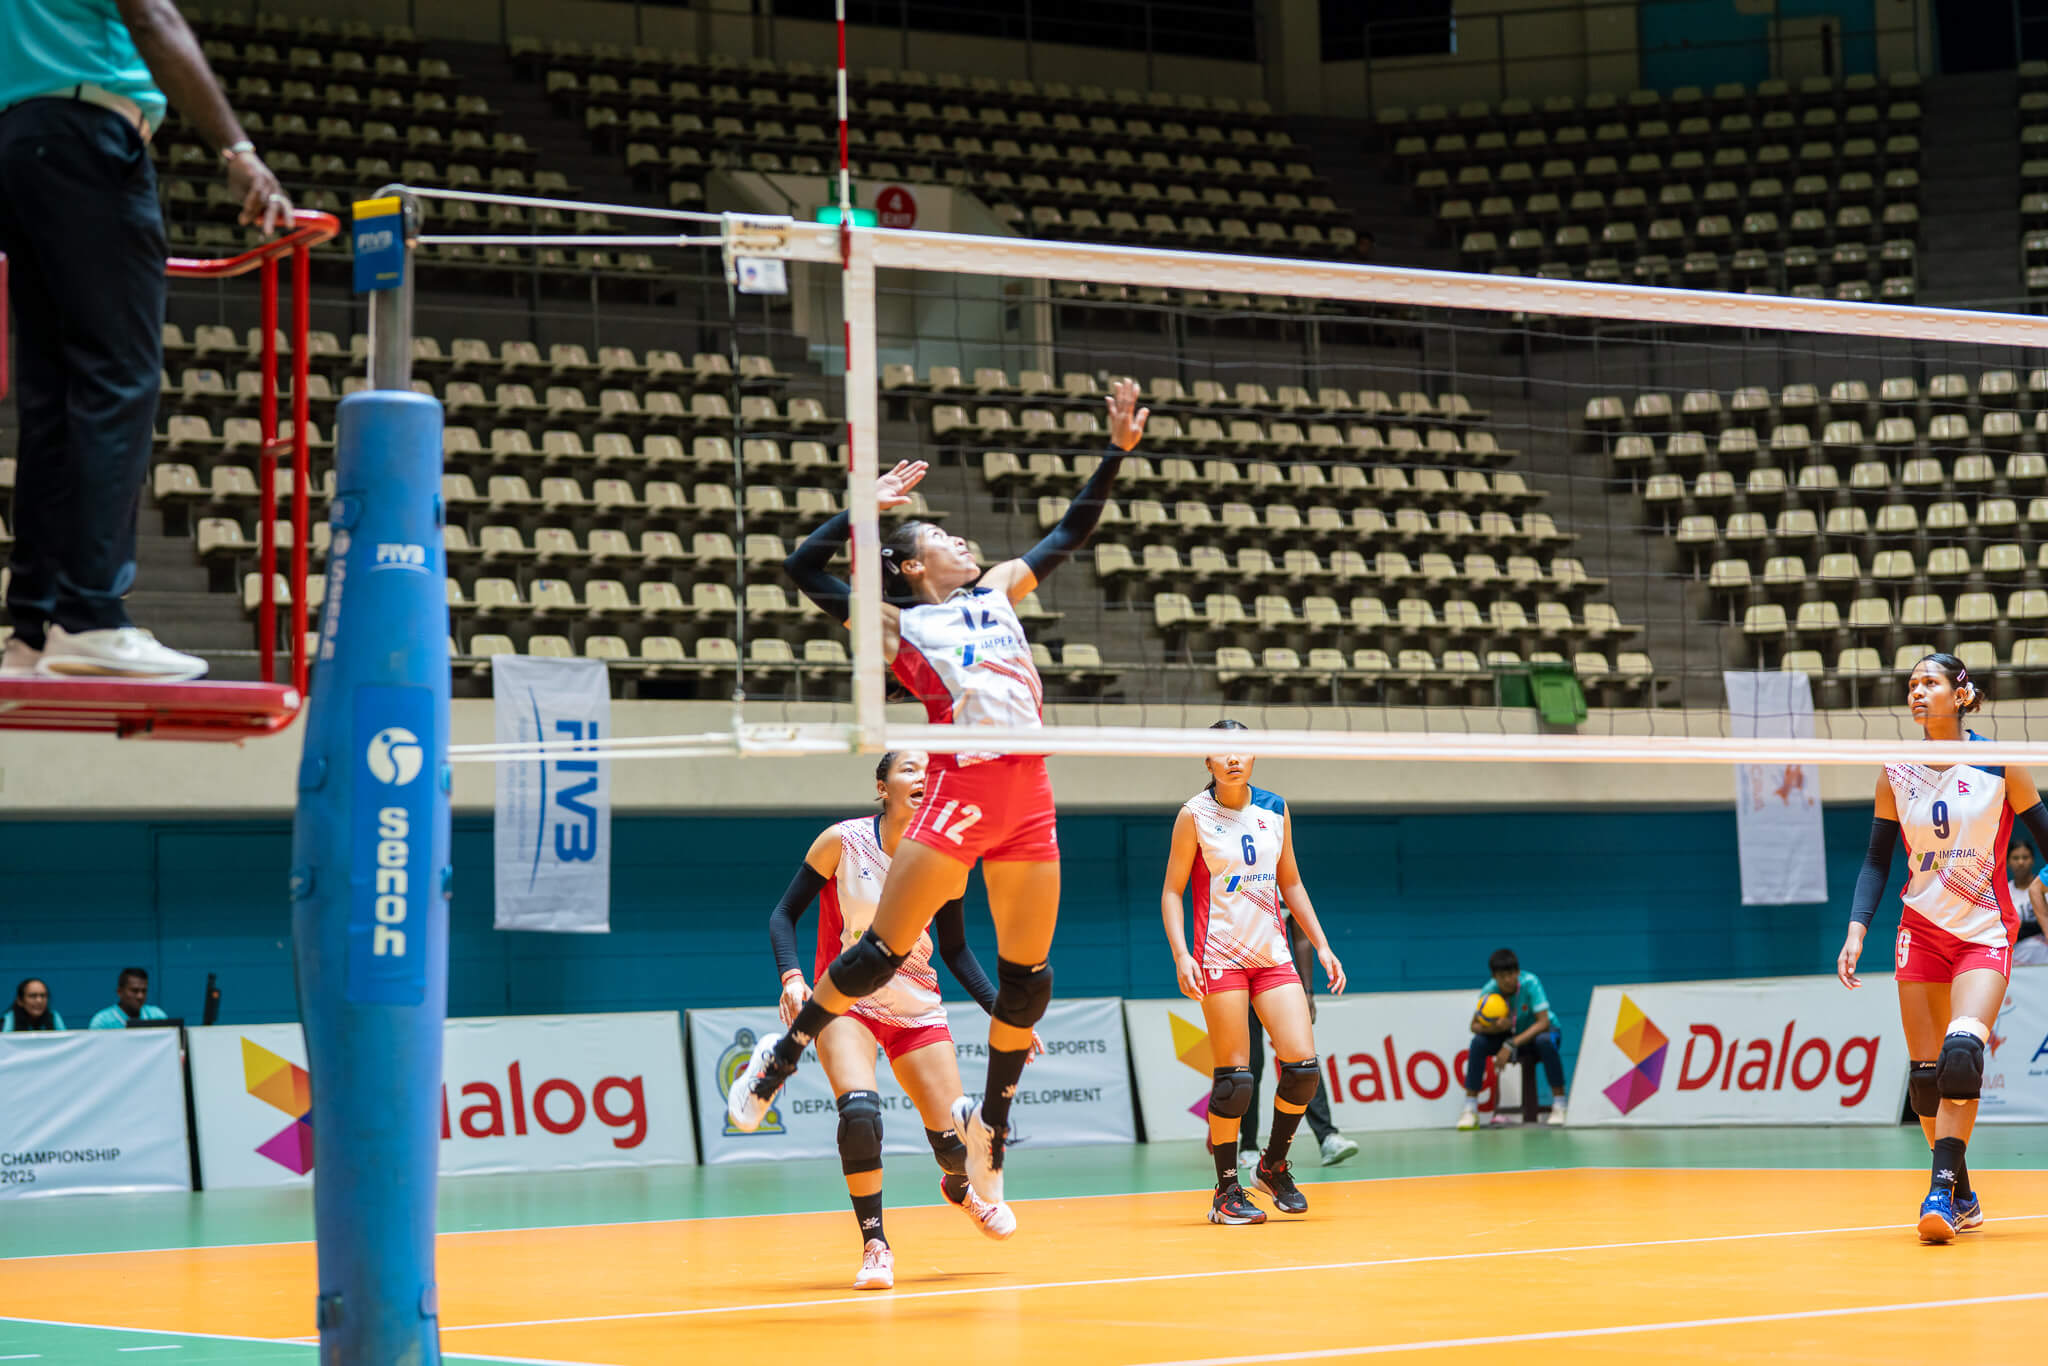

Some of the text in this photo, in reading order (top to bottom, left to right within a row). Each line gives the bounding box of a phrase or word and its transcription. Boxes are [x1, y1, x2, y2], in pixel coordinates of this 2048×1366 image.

[888, 193, 903, 211] 4
[376, 543, 425, 564] FIVB
[555, 720, 598, 862] FIVB
[932, 800, 983, 846] 12
[1932, 800, 1950, 839] 9
[1241, 834, 1257, 866] 6
[1939, 848, 1976, 859] IMPERIAL
[1897, 928, 1912, 969] 9
[1046, 1039, 1106, 1055] SPORTS
[1270, 1034, 1498, 1112] ialog
[1677, 1019, 1881, 1108] Dialog
[440, 1059, 648, 1150] ialog
[1014, 1087, 1102, 1104] VELOPMENT
[0, 1147, 121, 1167] CHAMPIONSHIP
[0, 1169, 37, 1185] 2025
